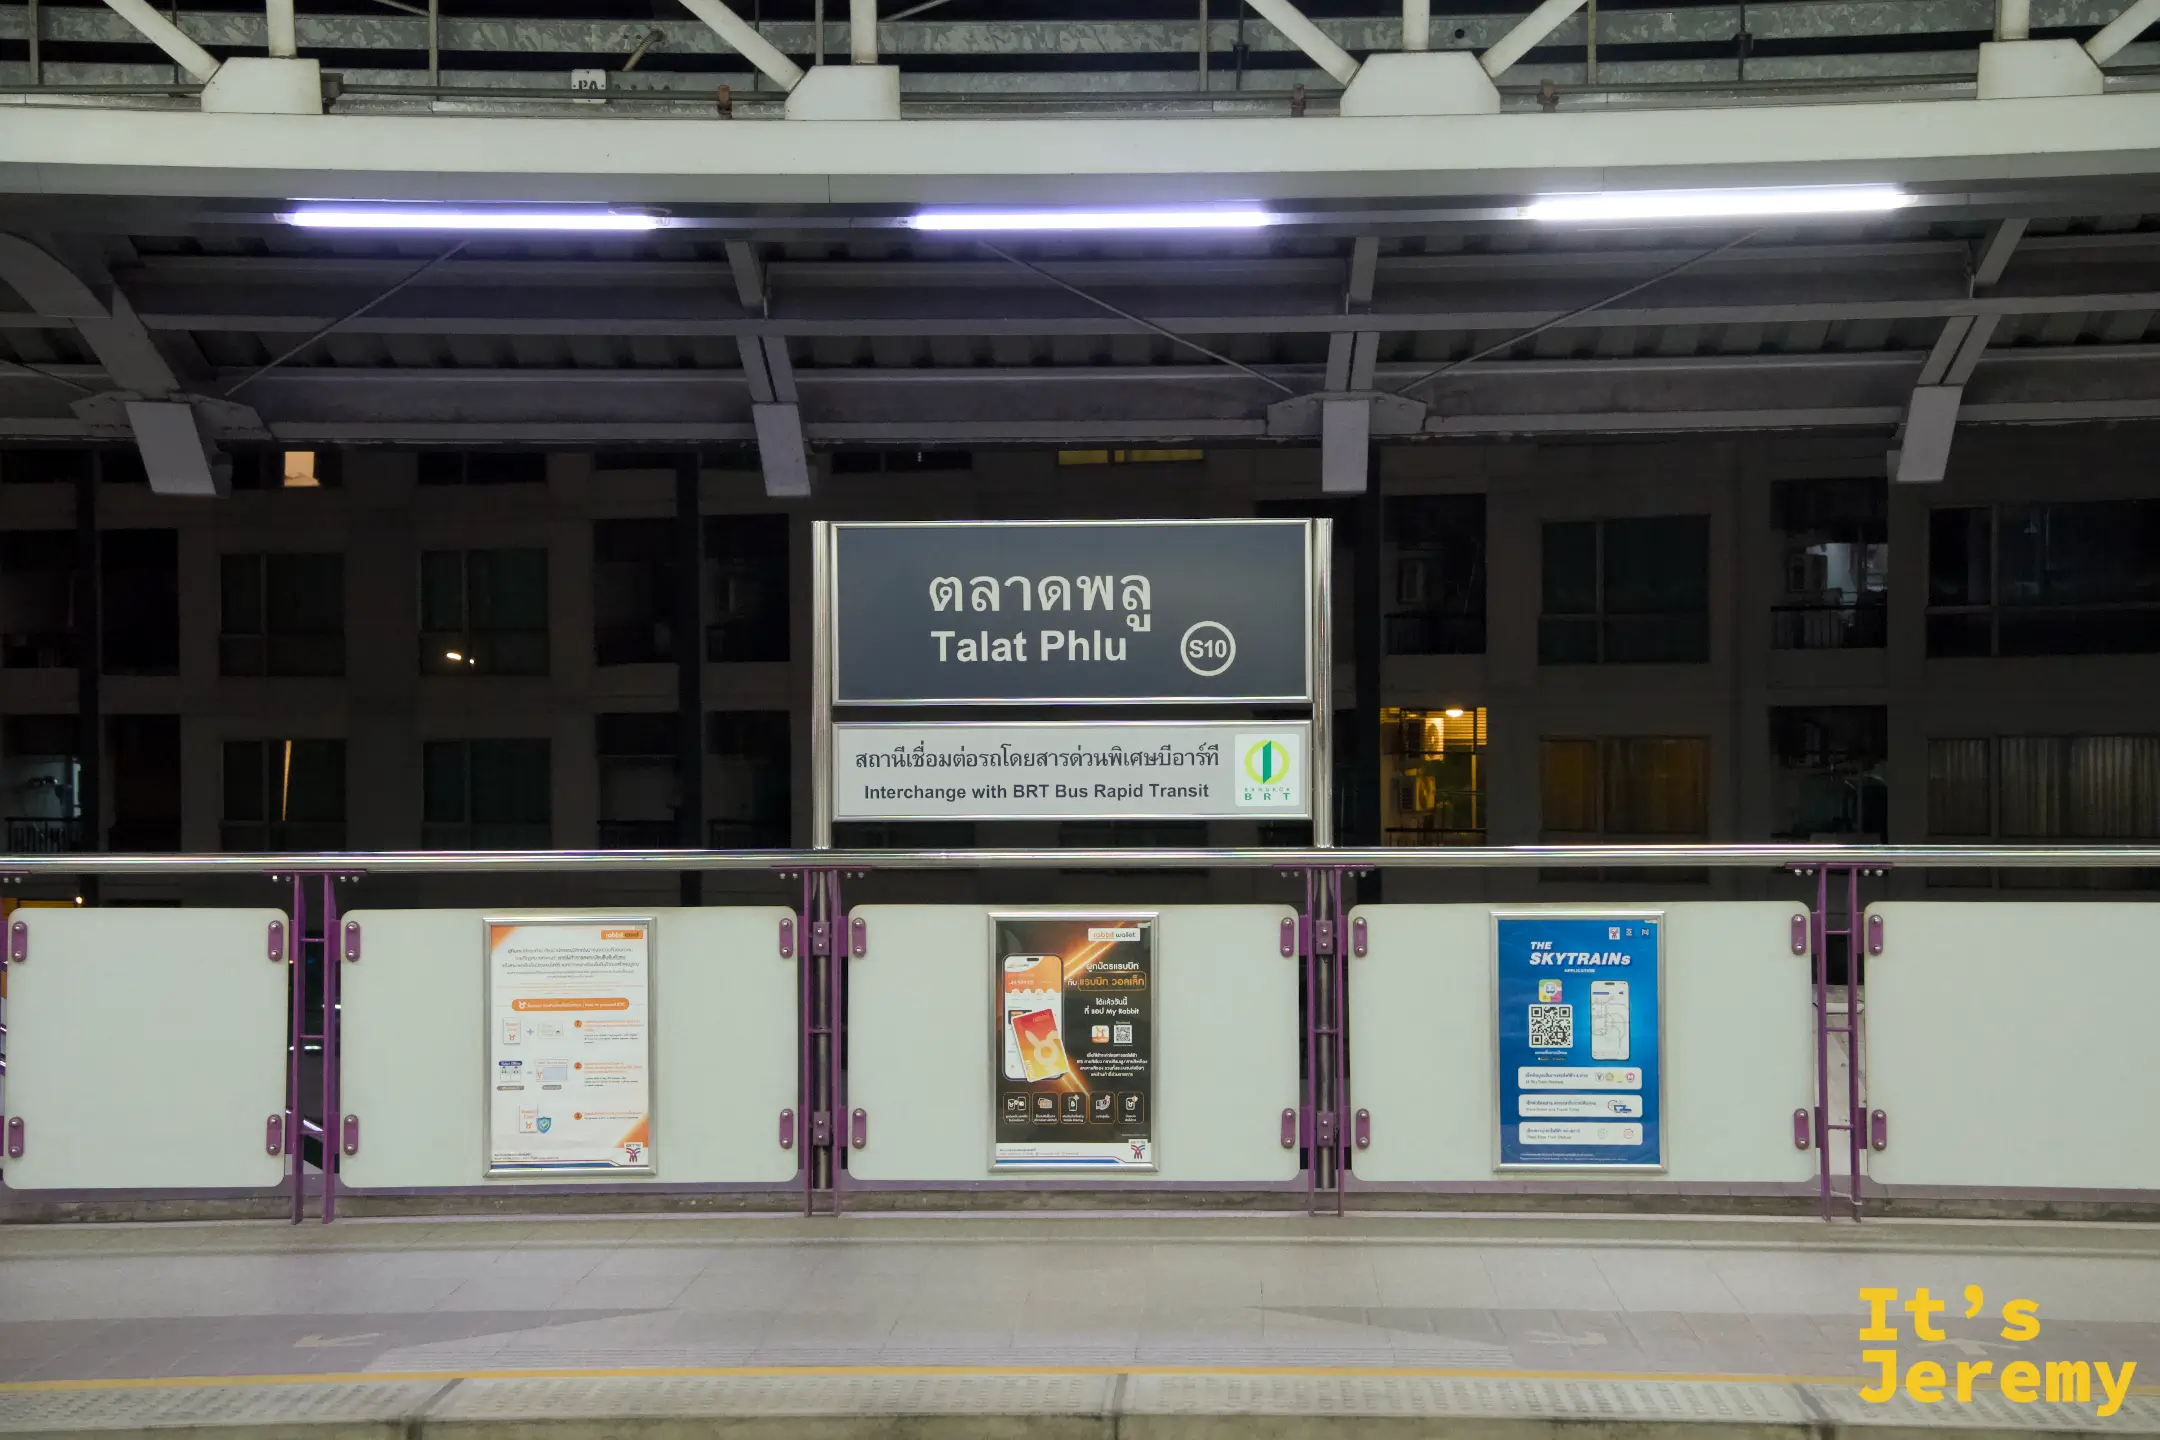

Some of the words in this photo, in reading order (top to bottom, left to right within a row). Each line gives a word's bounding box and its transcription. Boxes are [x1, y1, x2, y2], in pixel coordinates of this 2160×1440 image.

[929, 575, 1150, 632] ตลาดพลู
[930, 630, 1028, 662] Talat
[1041, 630, 1127, 661] Phlu
[1189, 639, 1228, 659] S10
[855, 741, 1220, 768] สถานีเชื่อมต่อรถโดยสารด่วนพิเศษบีอาร์ที
[864, 785, 967, 802] Interchange
[972, 784, 1007, 799] with
[1013, 784, 1050, 798] BRT
[1055, 784, 1088, 798] Bus
[1094, 783, 1144, 801] Rapid
[1149, 783, 1209, 798] Transit
[1530, 941, 1553, 950] THE
[1529, 952, 1631, 966] SKYTRAINs
[1106, 1008, 1117, 1016] My
